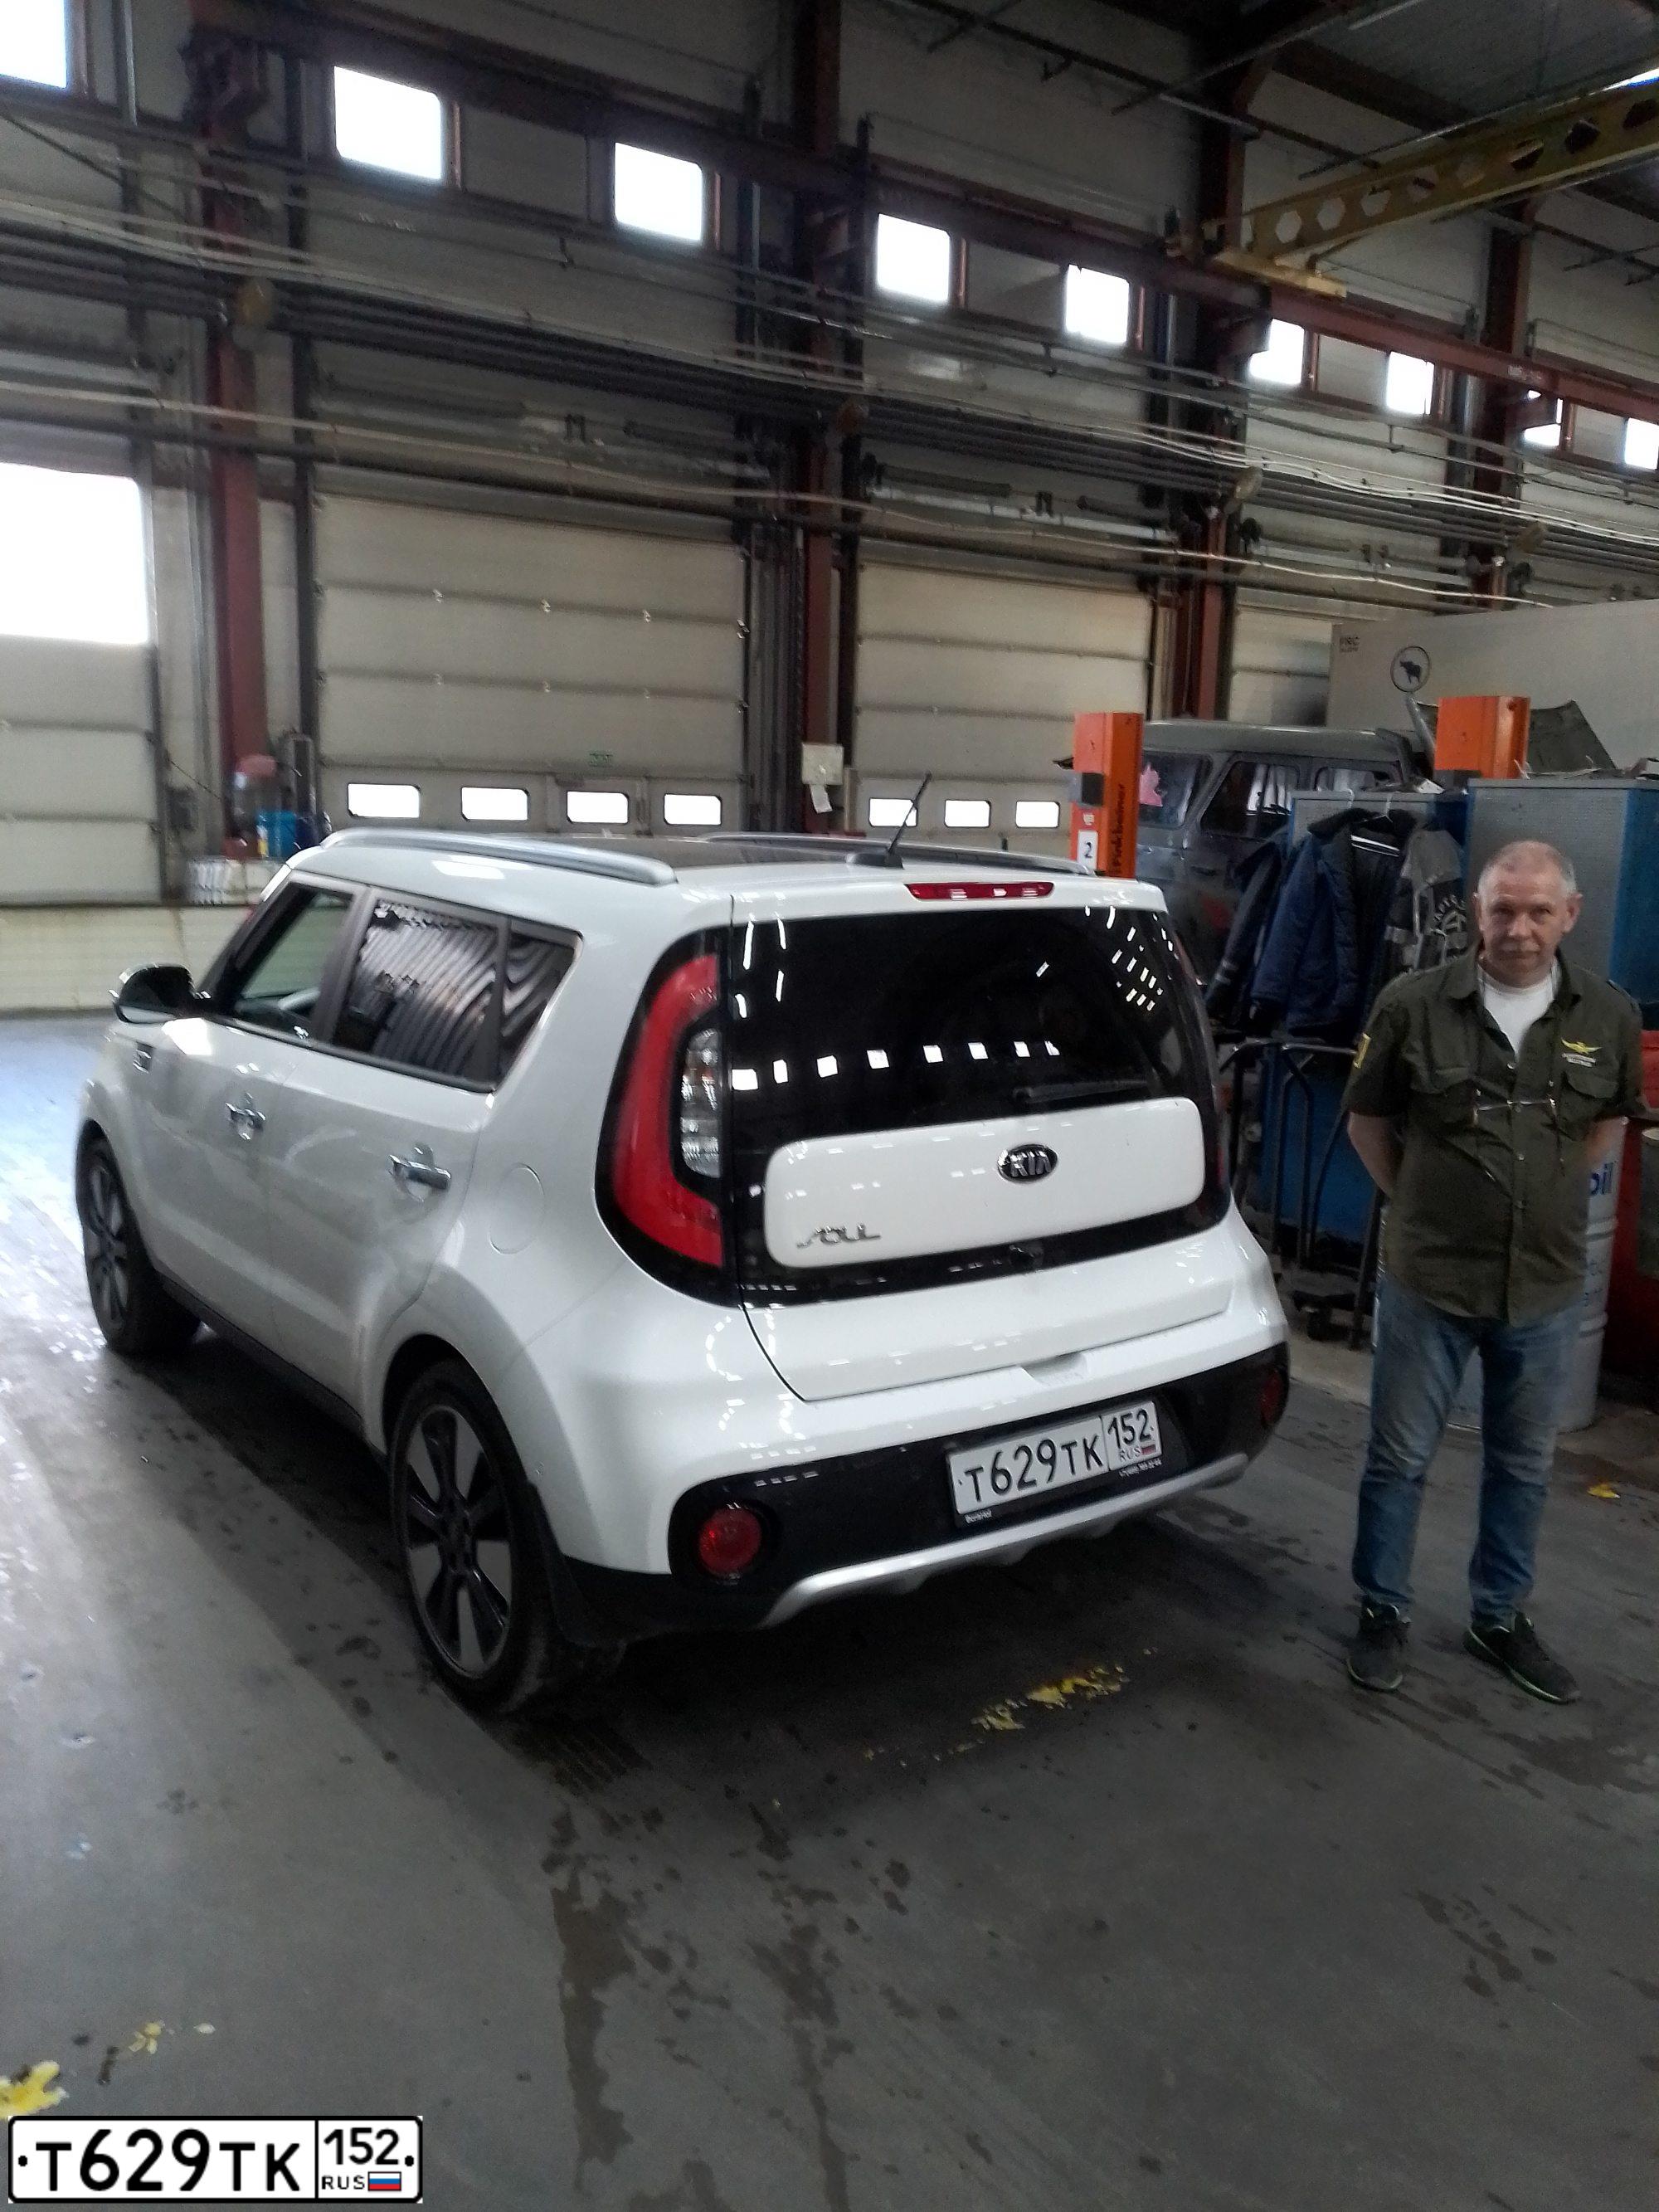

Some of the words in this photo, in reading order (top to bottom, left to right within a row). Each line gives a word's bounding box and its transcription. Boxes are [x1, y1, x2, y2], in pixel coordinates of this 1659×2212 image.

[1084, 841, 1093, 859] 2
[1009, 1150, 1053, 1178] KIA
[1107, 1408, 1151, 1449] 152
[1118, 1445, 1141, 1463] RUS
